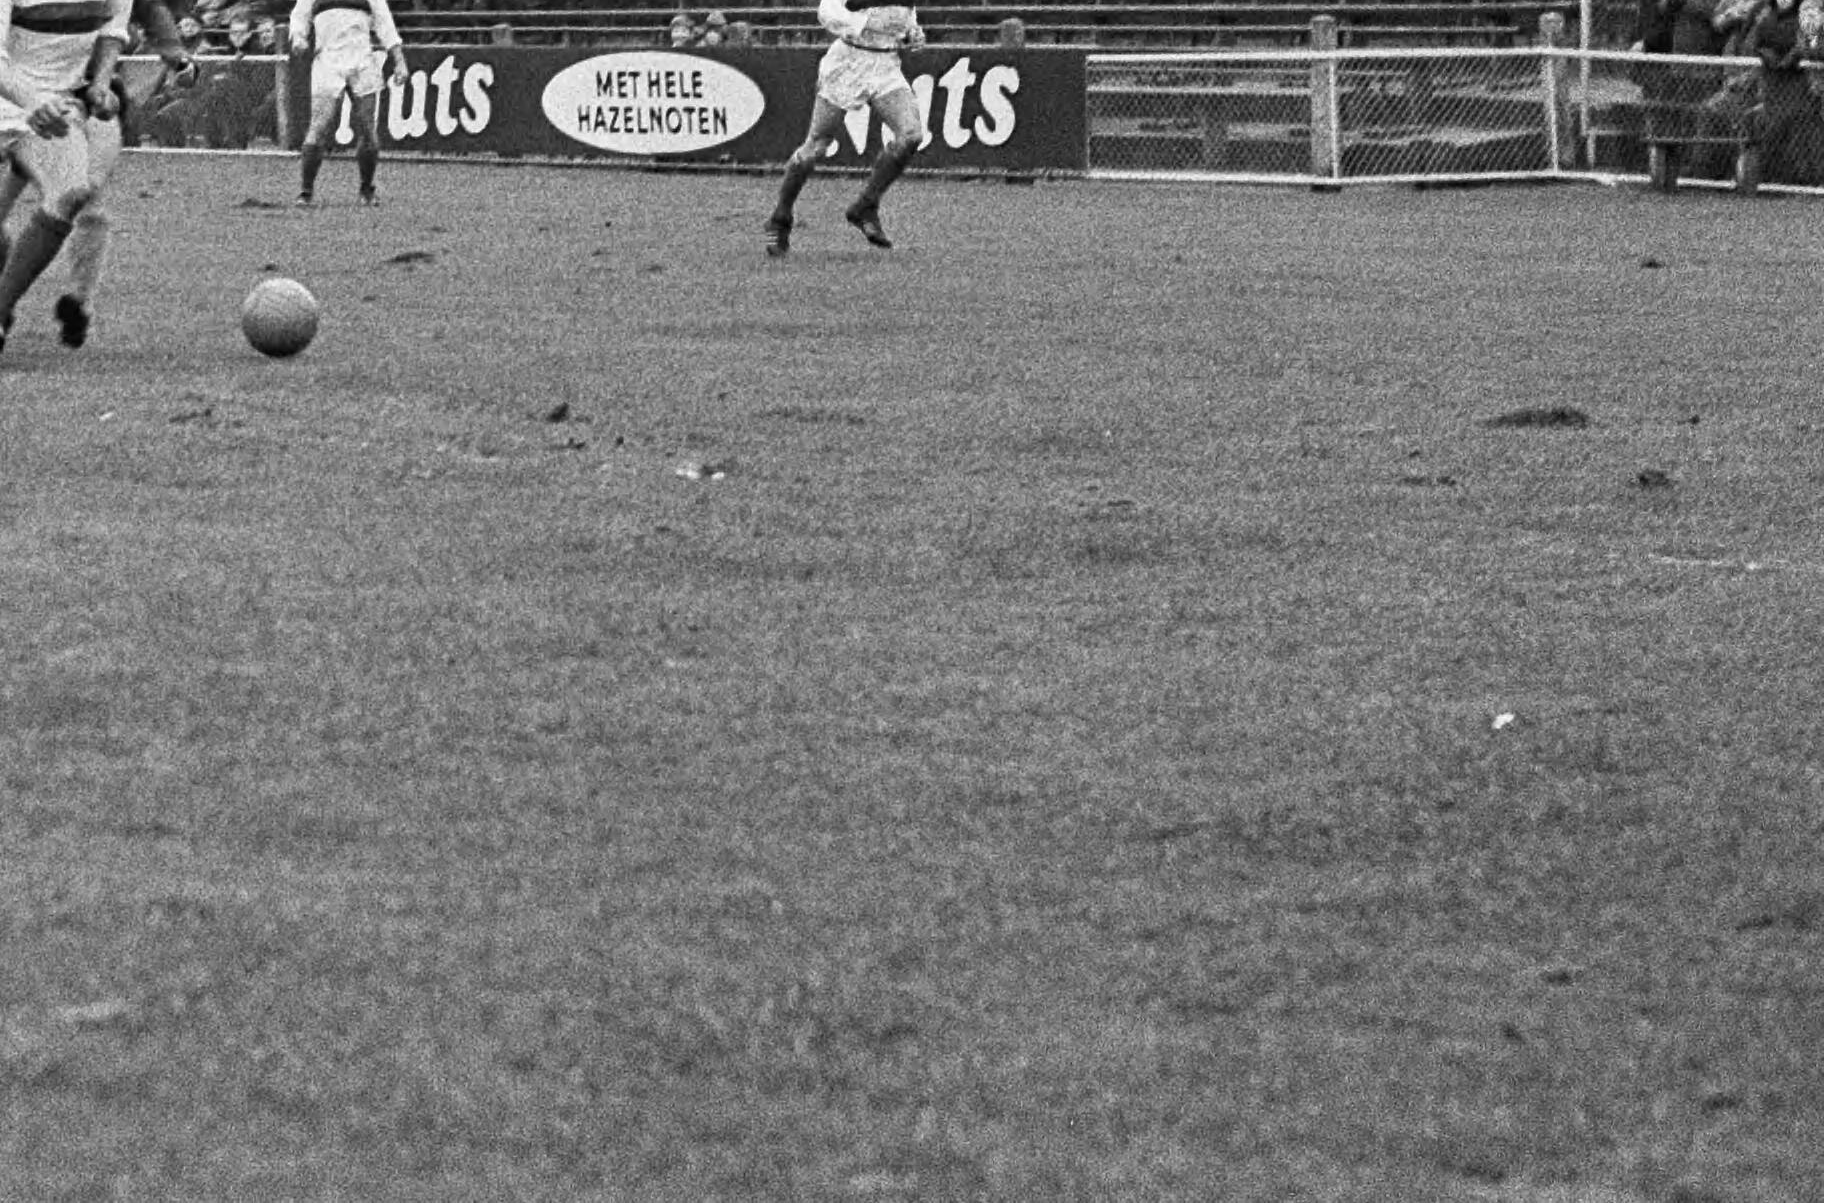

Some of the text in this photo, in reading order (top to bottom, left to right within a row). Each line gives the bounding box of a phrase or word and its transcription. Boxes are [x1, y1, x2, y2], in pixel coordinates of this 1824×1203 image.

[335, 50, 495, 145] uts
[596, 70, 704, 99] MET HELE
[577, 105, 729, 135] HAZELNOTEN
